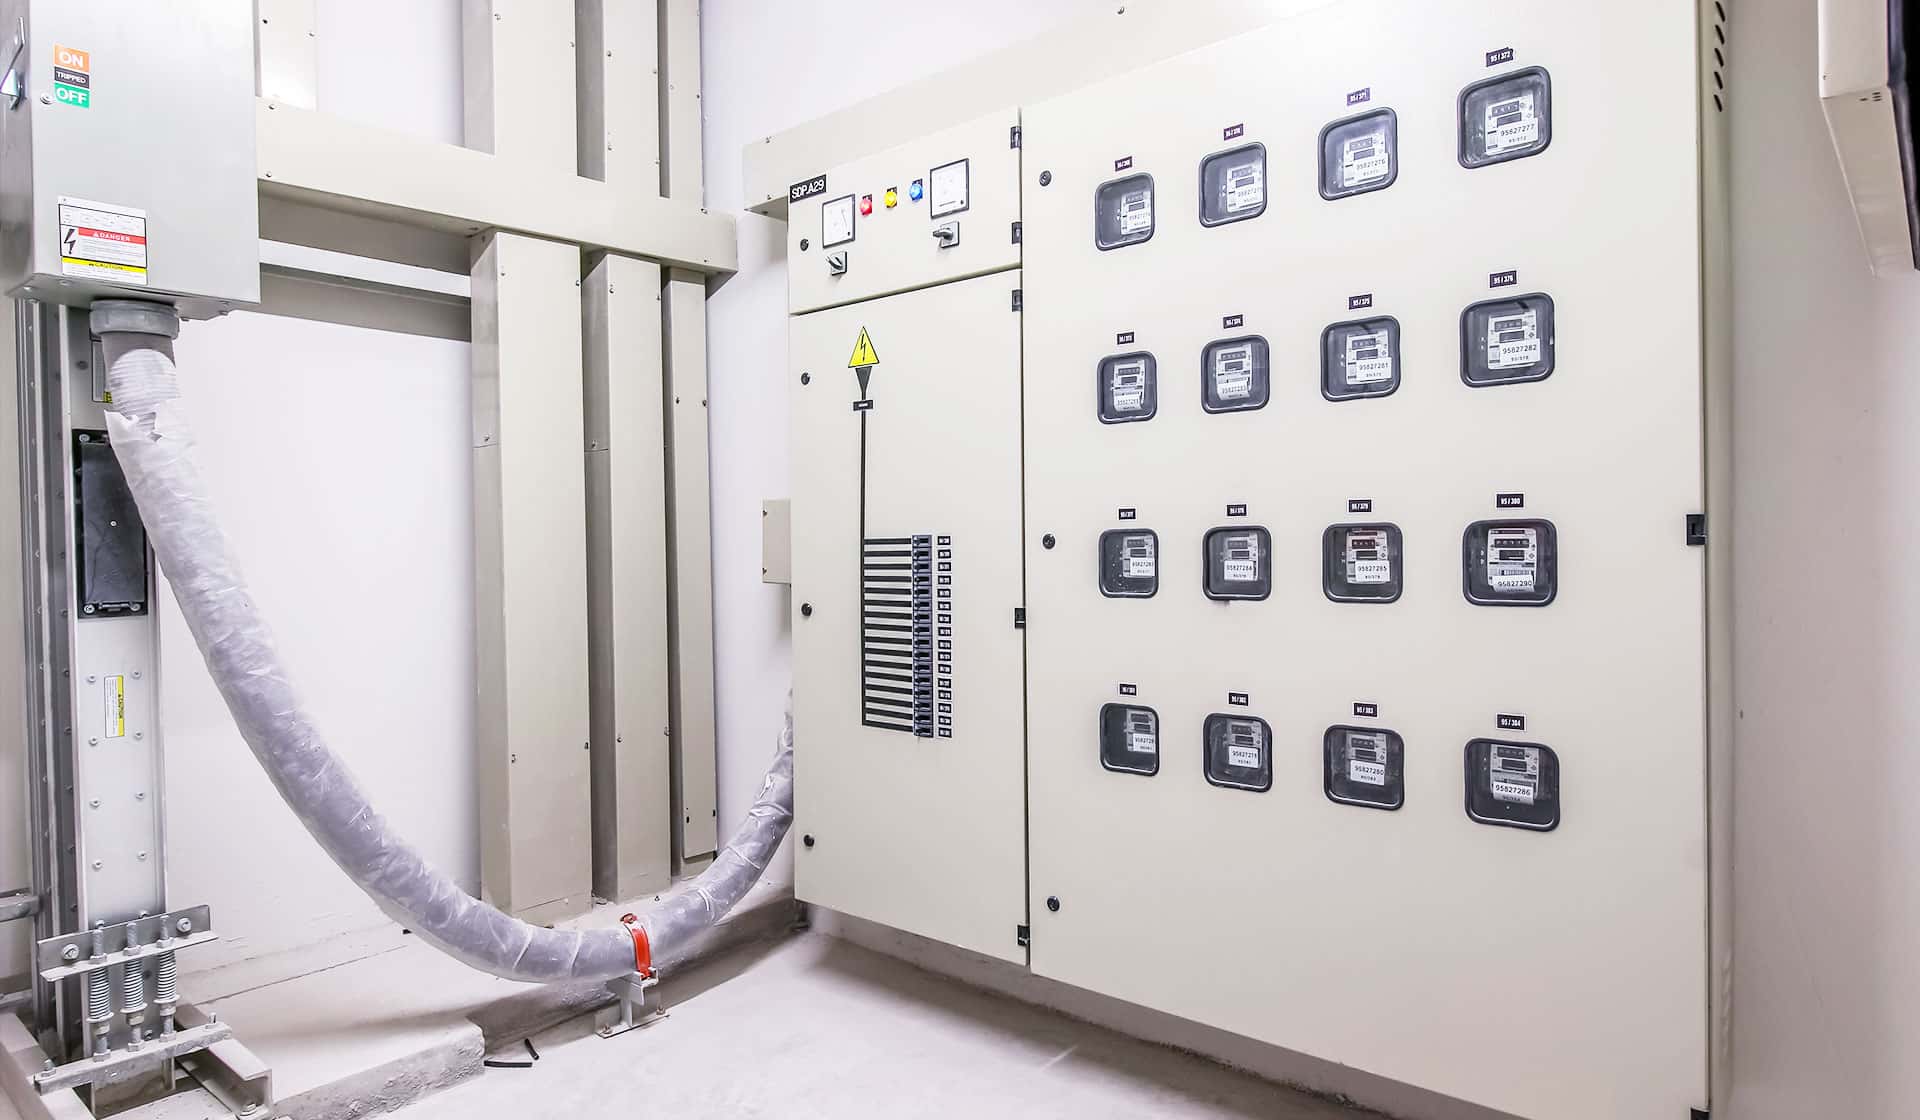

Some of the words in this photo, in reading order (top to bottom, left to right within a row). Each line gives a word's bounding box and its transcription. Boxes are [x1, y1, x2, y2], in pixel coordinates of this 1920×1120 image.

[59, 52, 84, 68] ON
[57, 88, 87, 104] OFF
[99, 233, 130, 241] DANGER
[1502, 344, 1537, 354] 95827282
